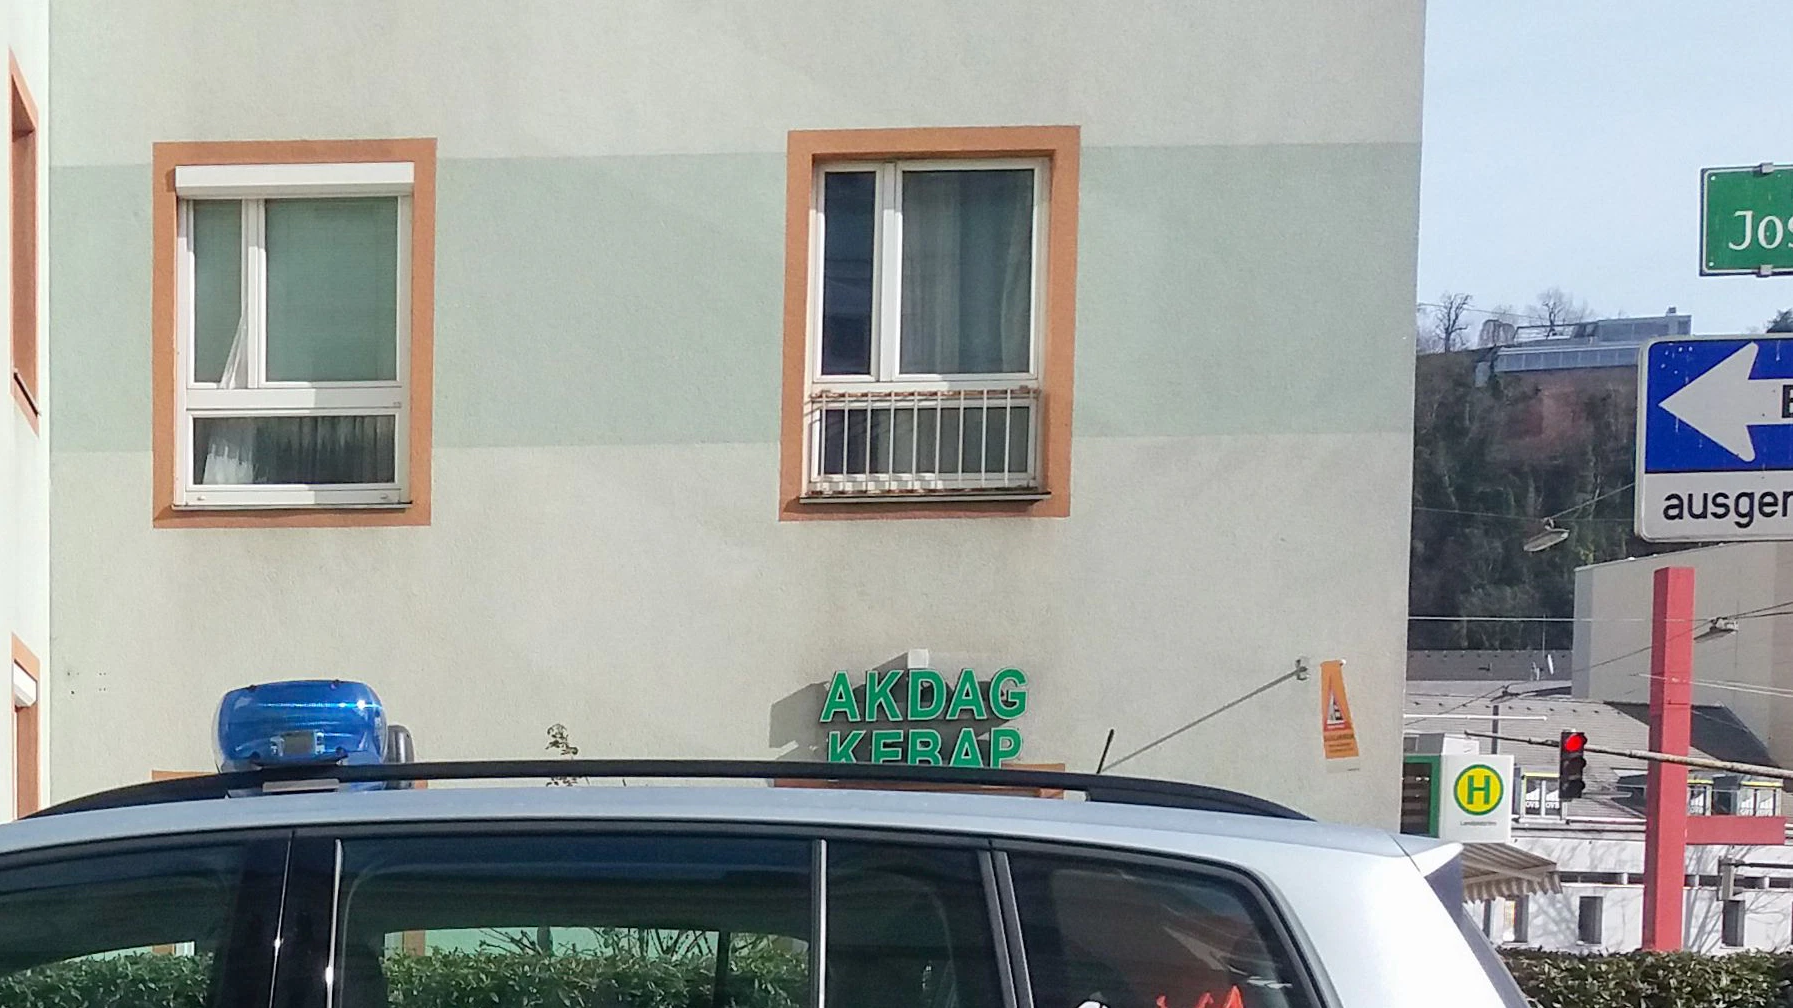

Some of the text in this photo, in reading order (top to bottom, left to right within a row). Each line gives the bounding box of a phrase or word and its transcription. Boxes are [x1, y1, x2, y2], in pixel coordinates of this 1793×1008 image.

[820, 667, 1029, 723] AKDAG
[827, 727, 1024, 768] KEBAP
[1467, 775, 1491, 805] H
